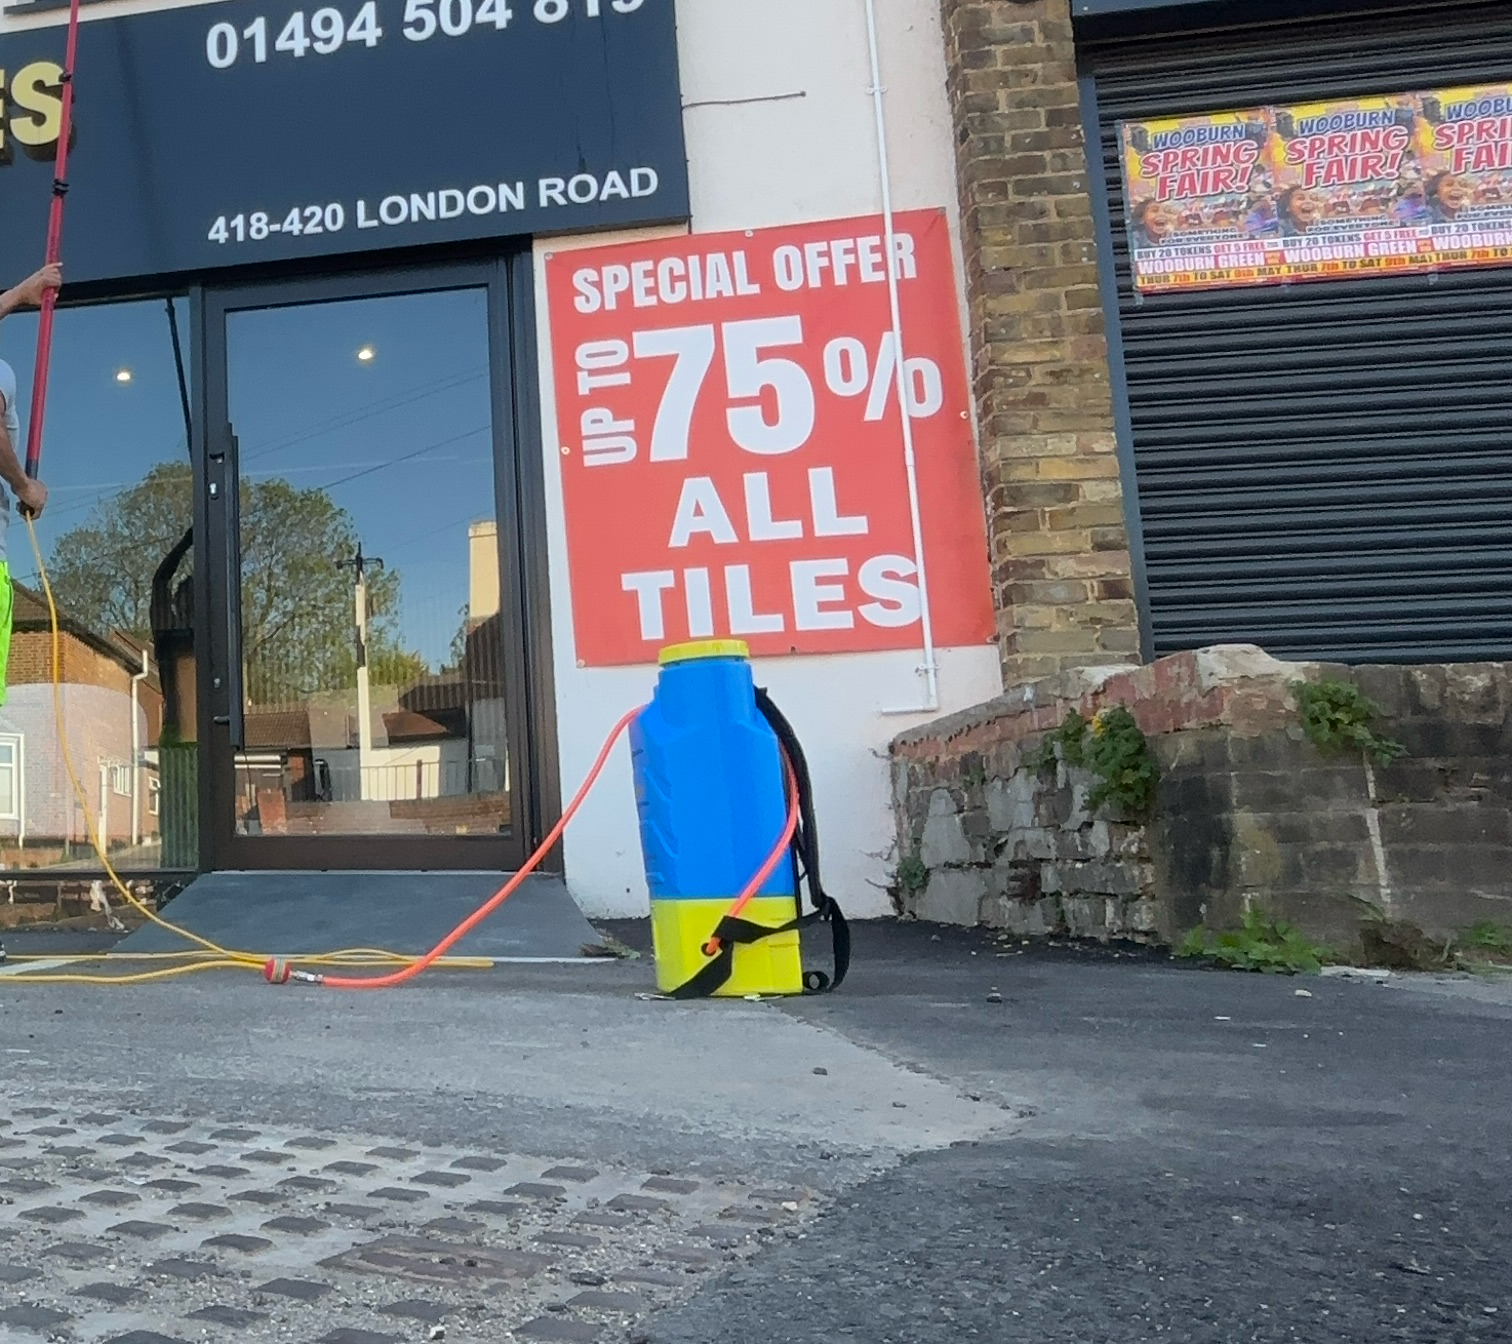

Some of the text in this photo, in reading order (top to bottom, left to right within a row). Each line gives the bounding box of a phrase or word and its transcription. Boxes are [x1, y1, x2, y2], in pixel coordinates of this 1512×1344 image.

[206, 1, 383, 68] 01494
[1152, 124, 1246, 151] WOOBURN
[1297, 110, 1395, 136] WOOBURN
[1432, 116, 1512, 150] SPRI
[1140, 139, 1258, 178] SPRING
[1286, 125, 1409, 164] SPRING
[1450, 141, 1512, 175] FAI
[1155, 164, 1253, 202] FAIR!
[1303, 150, 1403, 189] FAIR!
[207, 167, 659, 244] 418-420 LONDON ROAD
[1137, 257, 1216, 275] WOOBURN
[1217, 252, 1265, 269] GREEN
[1283, 244, 1366, 264] WOOBURN
[1367, 240, 1417, 257] GREEN
[572, 232, 917, 314] SPECIAL OFFER
[574, 338, 638, 467] UP TO
[631, 314, 944, 464] 75%
[667, 466, 869, 549] ALL
[620, 554, 924, 641] TILES
